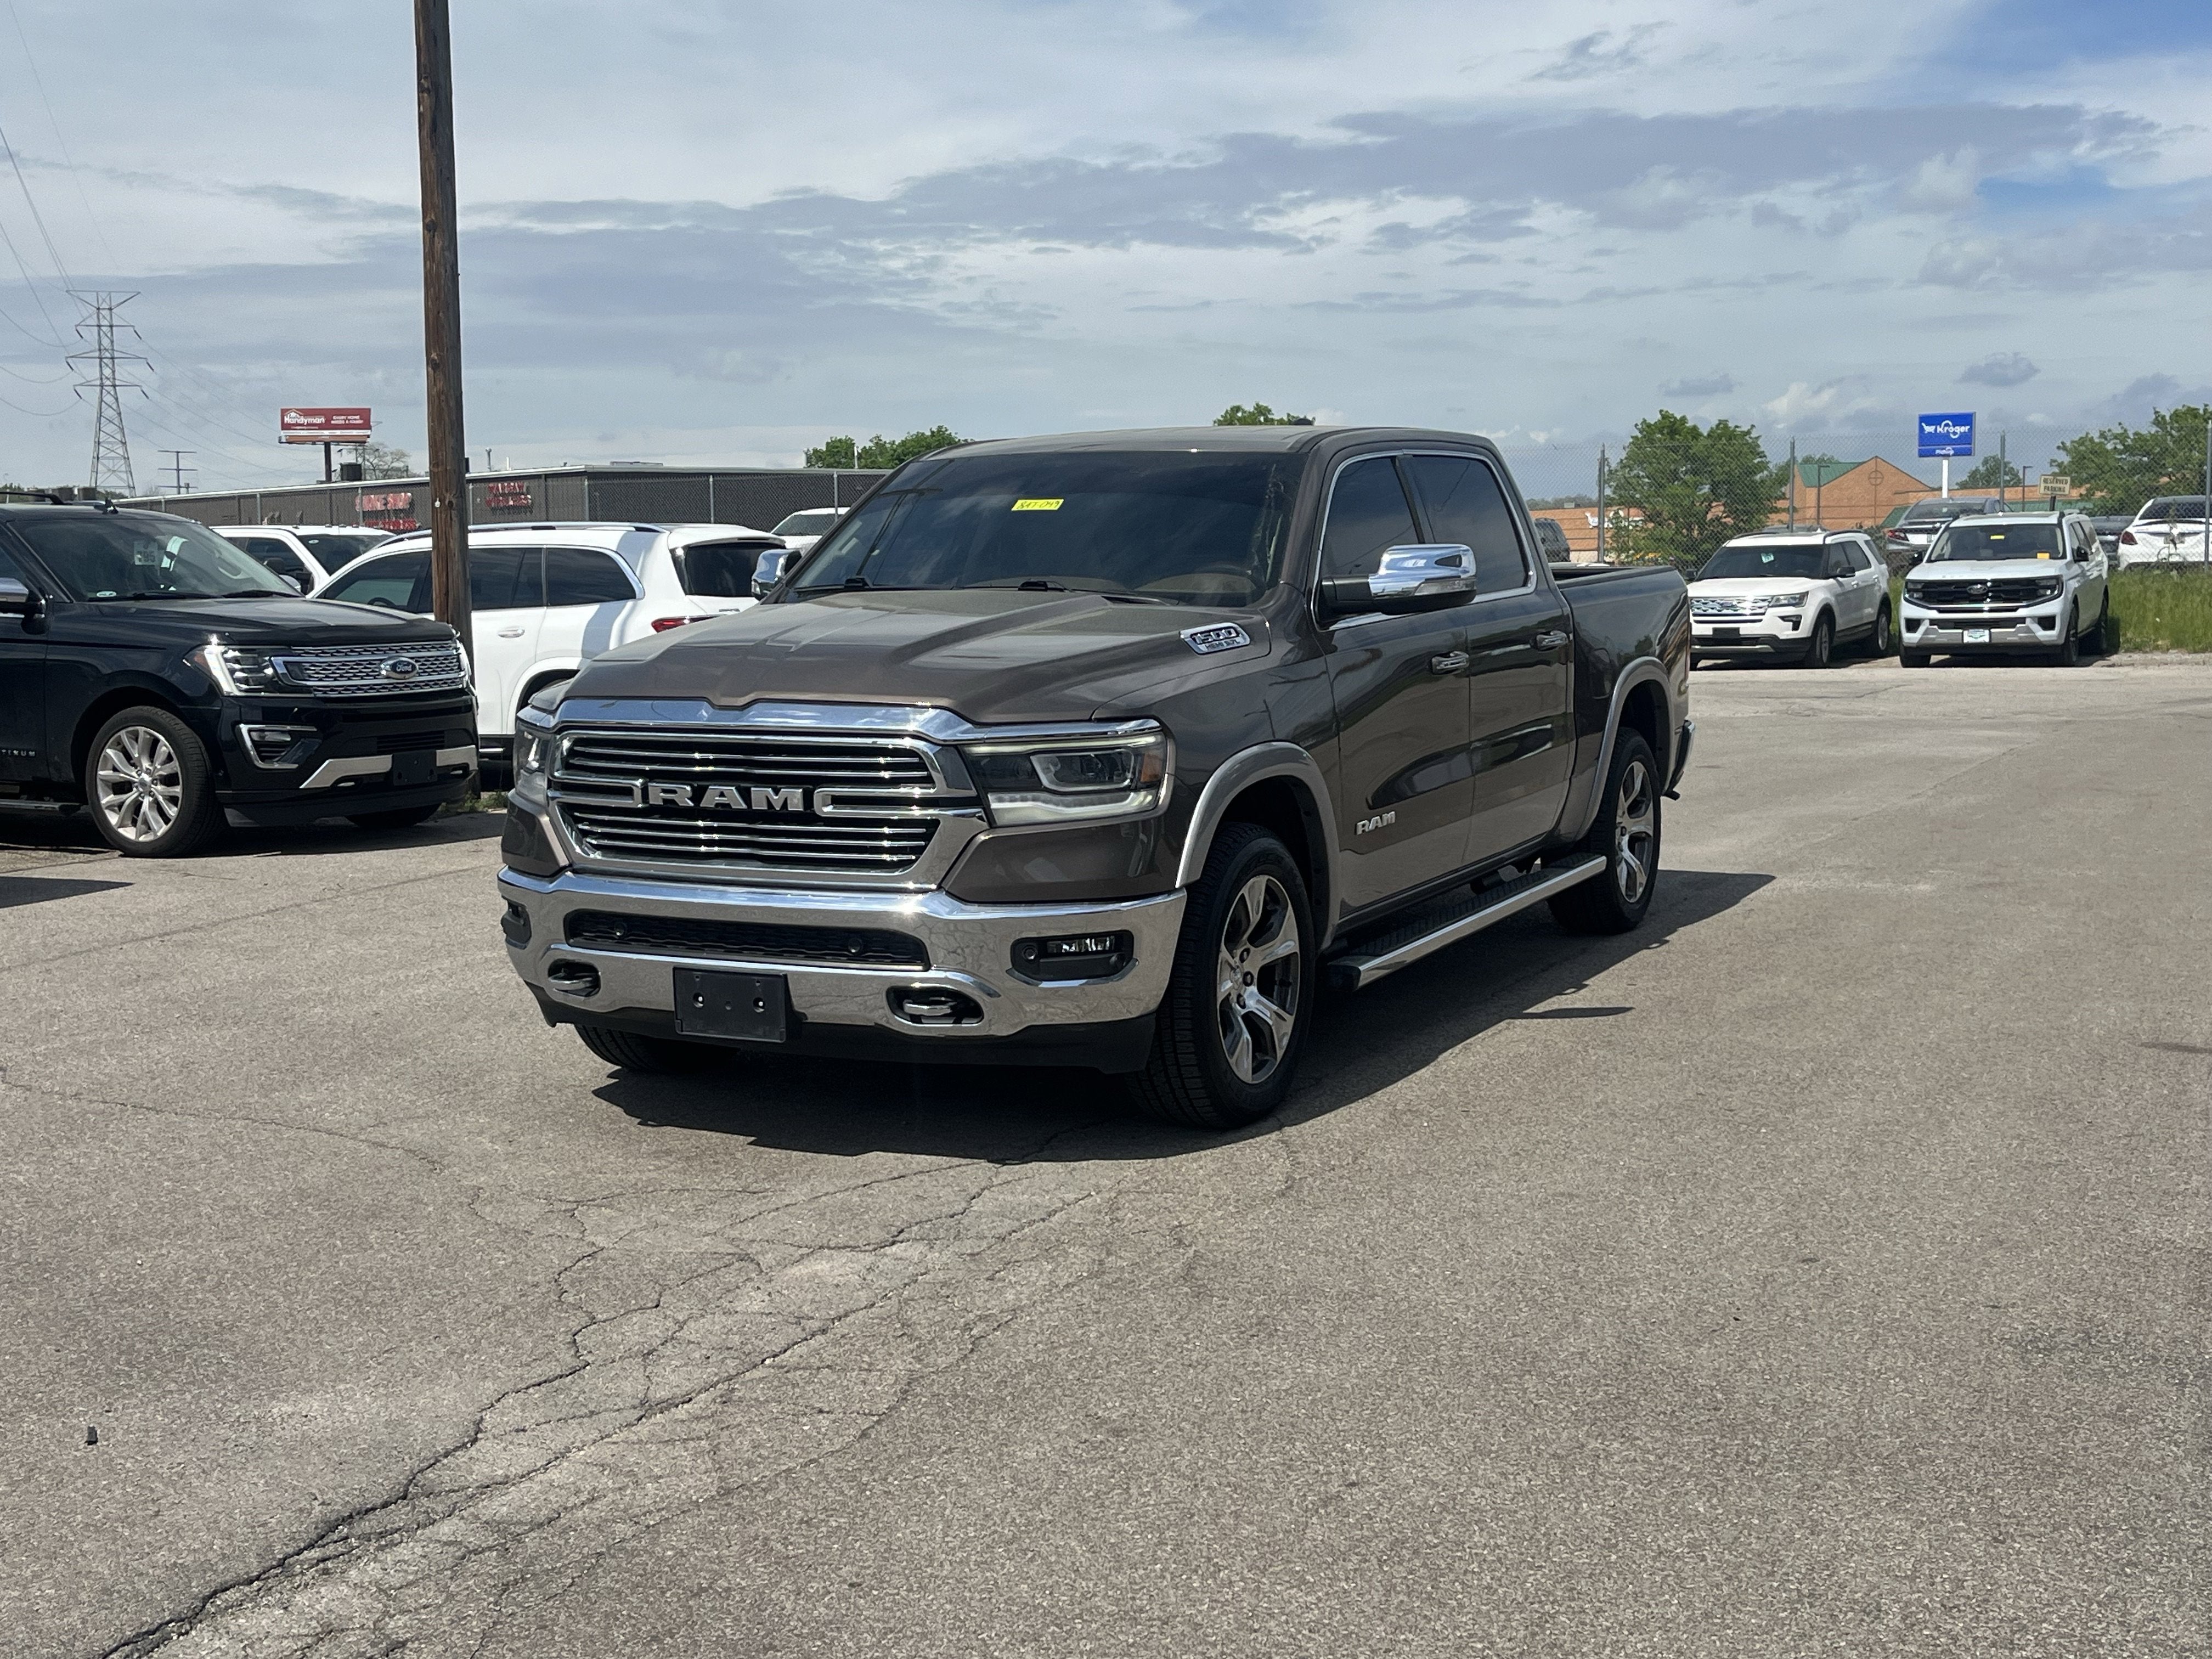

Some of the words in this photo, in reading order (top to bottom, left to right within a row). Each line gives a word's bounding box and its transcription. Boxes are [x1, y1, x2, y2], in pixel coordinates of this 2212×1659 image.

[284, 414, 325, 425] Handyman
[1937, 420, 1970, 438] Kroger
[1191, 628, 1238, 644] 1500
[396, 662, 413, 672] Ford
[648, 782, 804, 811] RAM
[1356, 811, 1395, 835] RAM
